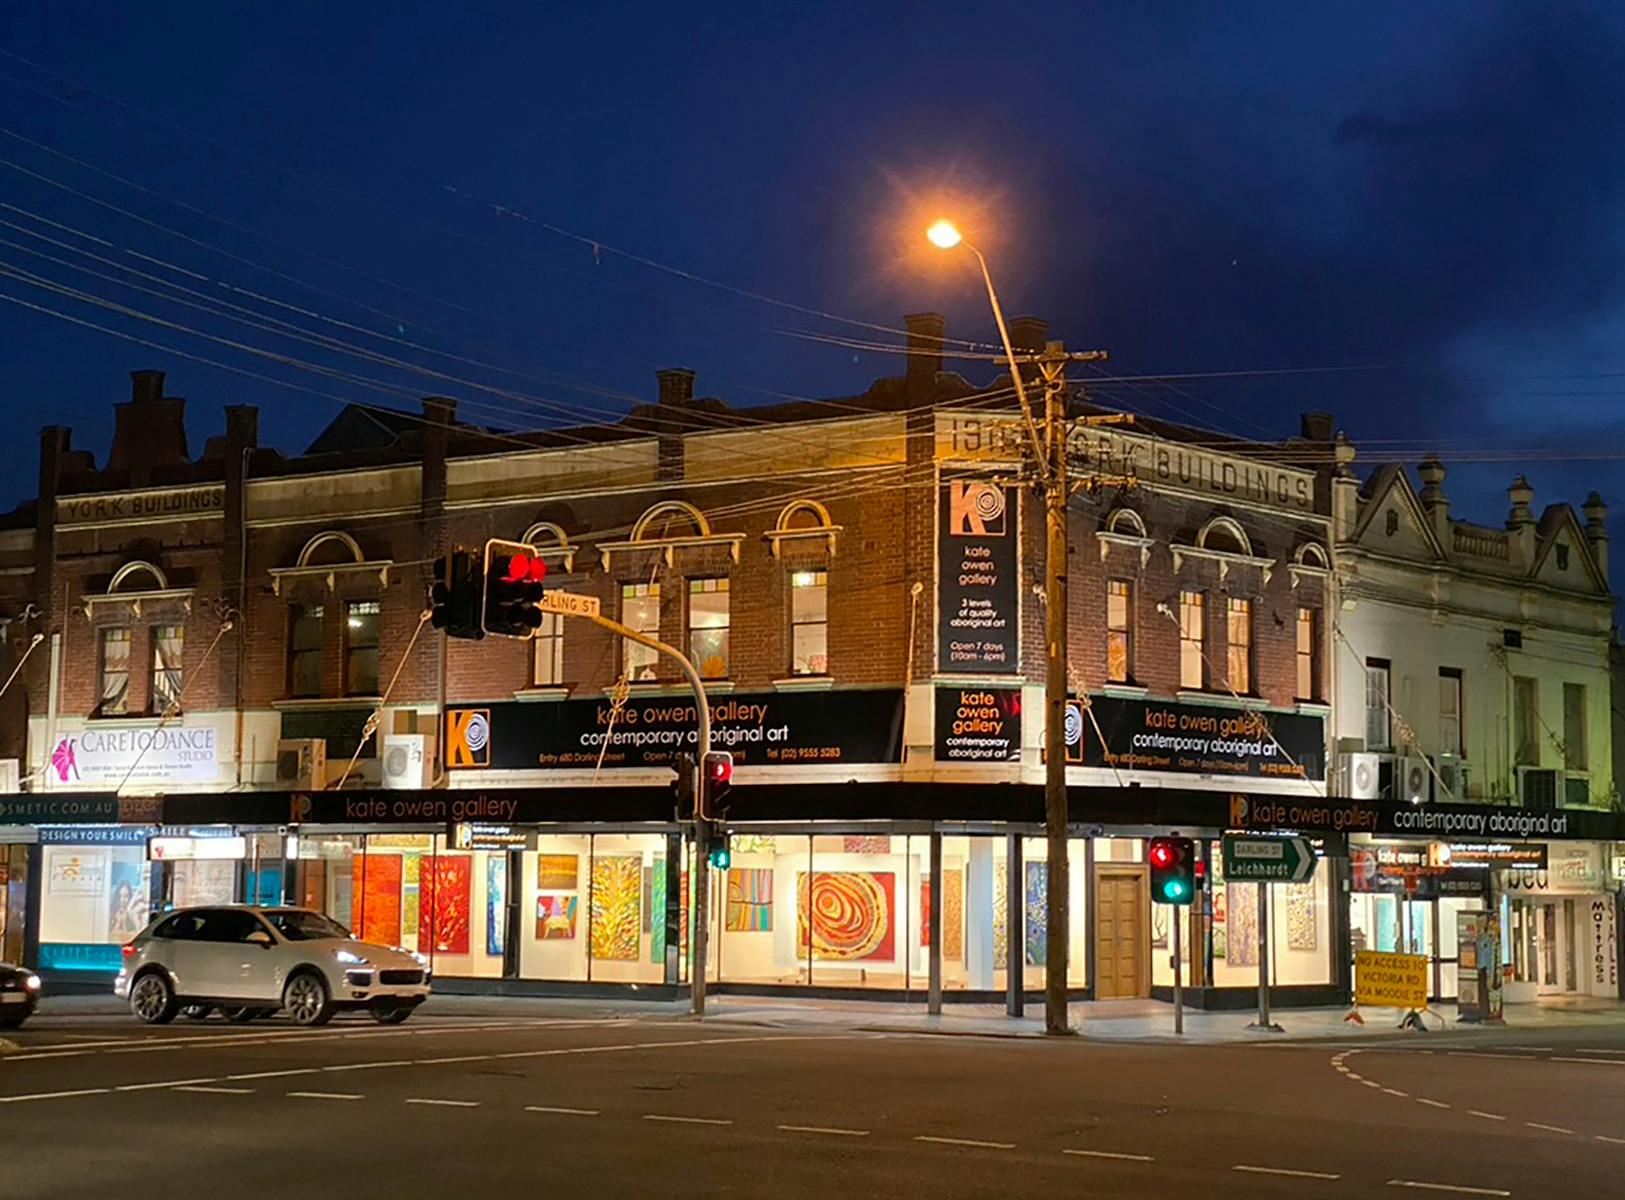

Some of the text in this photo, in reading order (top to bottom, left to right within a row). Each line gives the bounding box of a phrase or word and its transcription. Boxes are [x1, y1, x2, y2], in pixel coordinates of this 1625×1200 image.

[1073, 433, 1309, 507] ORK BUILDINGS
[68, 488, 222, 518] YORK BUILDINGS
[964, 546, 991, 558] kate
[961, 561, 994, 571] owen
[958, 573, 997, 586] gallery
[542, 595, 597, 612] RLING ST
[962, 598, 992, 608] 3 levels
[959, 608, 997, 619] of quality
[950, 618, 1006, 629] aboriginal art
[950, 641, 976, 651] Open
[982, 642, 1004, 652] days
[961, 690, 995, 706] kate
[597, 700, 768, 725] kate owen gallery
[957, 706, 1000, 719] owen
[1145, 707, 1177, 728] kate
[1180, 714, 1217, 733] owen
[952, 718, 1003, 735] gallery
[580, 724, 789, 748] contemporary aoriginal art
[946, 736, 1010, 748] contemporary
[1133, 732, 1278, 758] contemporary aboriginal art
[178, 750, 213, 762] STUDIO
[643, 751, 664, 762] Open
[948, 749, 1007, 760] aboriginal art
[346, 797, 387, 818] kate
[393, 799, 446, 818] owen
[452, 795, 518, 821] gallery
[1253, 799, 1286, 823] kate
[1290, 806, 1330, 825] owen
[1333, 805, 1379, 830] gallery
[1394, 810, 1568, 837] contemporary aboriginal art
[41, 830, 139, 841] DESIGN YOUR SMILE
[1229, 861, 1289, 876] Leichhardt
[1358, 955, 1425, 972] NO ACCESS TO
[1363, 971, 1420, 986] VICTORIA RD
[1358, 986, 1373, 996] VIA
[1413, 989, 1424, 1001] ST
